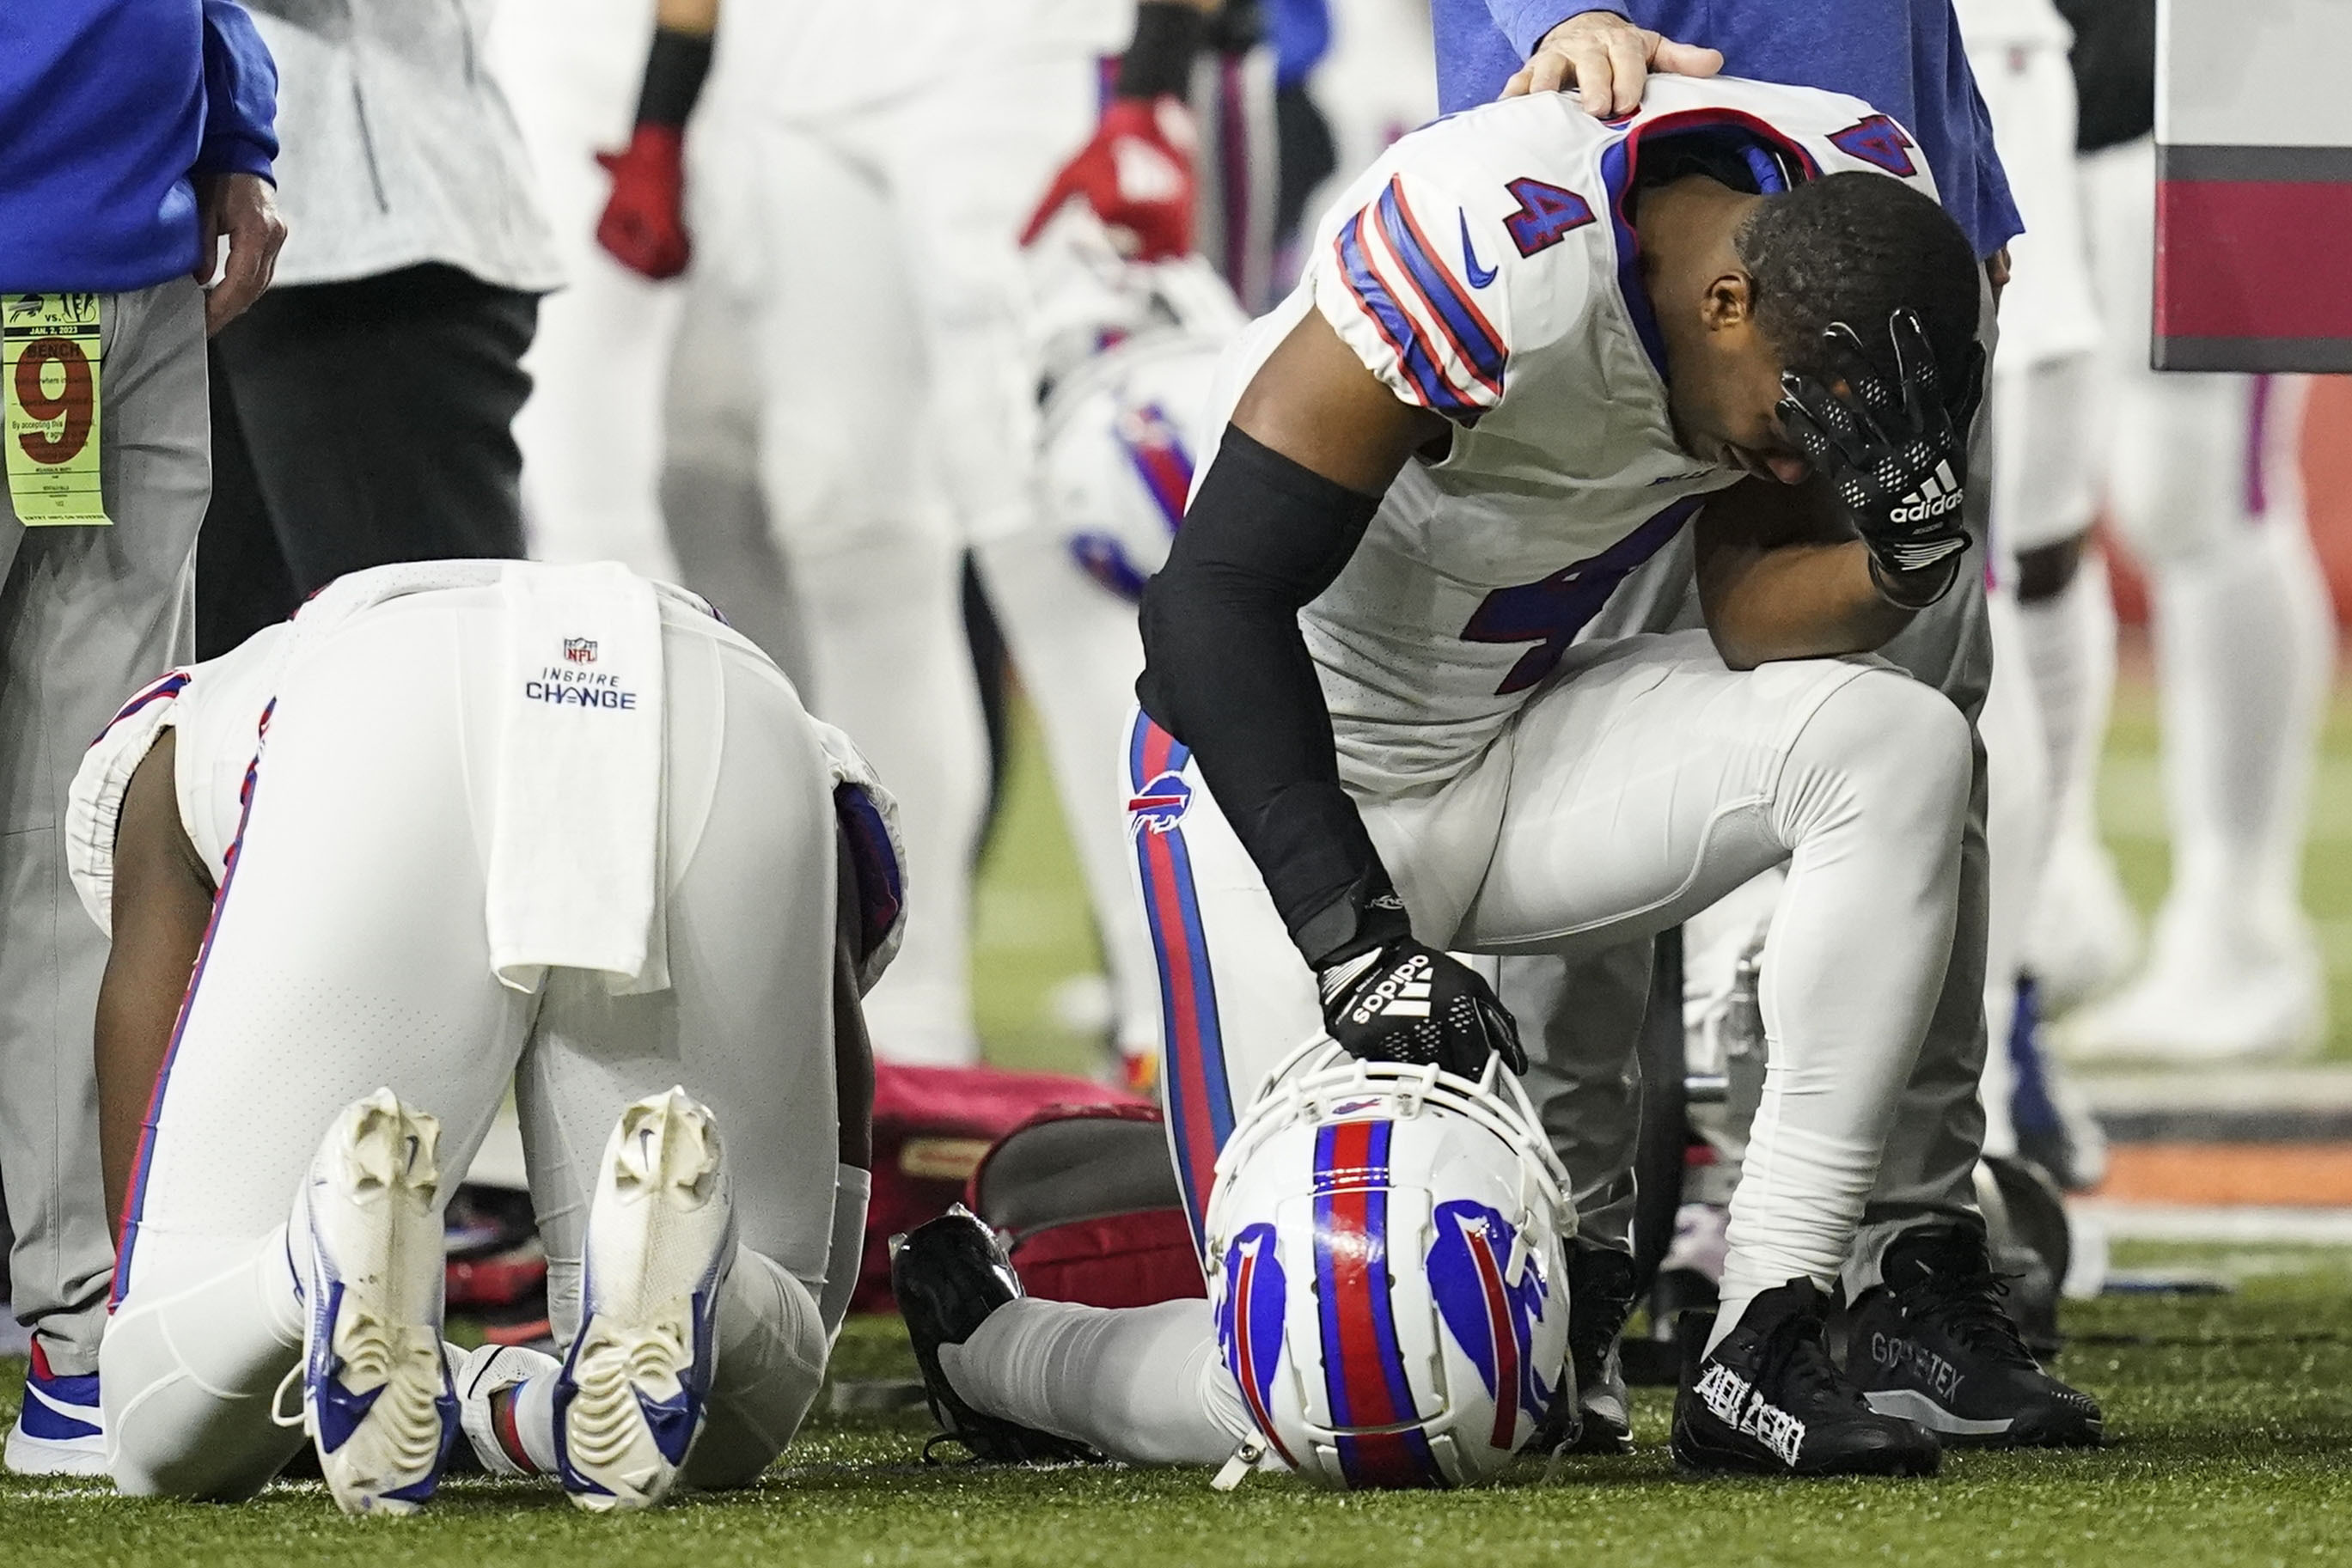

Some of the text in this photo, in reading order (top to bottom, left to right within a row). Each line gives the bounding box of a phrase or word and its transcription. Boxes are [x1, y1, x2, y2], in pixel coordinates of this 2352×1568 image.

[1502, 177, 1597, 259] 4
[27, 344, 80, 358] BENCH
[15, 337, 94, 465] 9
[12, 419, 64, 430] By accepting this
[1890, 488, 1964, 523] adidas
[567, 648, 596, 663] NFL
[542, 667, 620, 688] INSPIRE
[526, 681, 637, 711] CHANGE
[1352, 955, 1429, 1024] adidas
